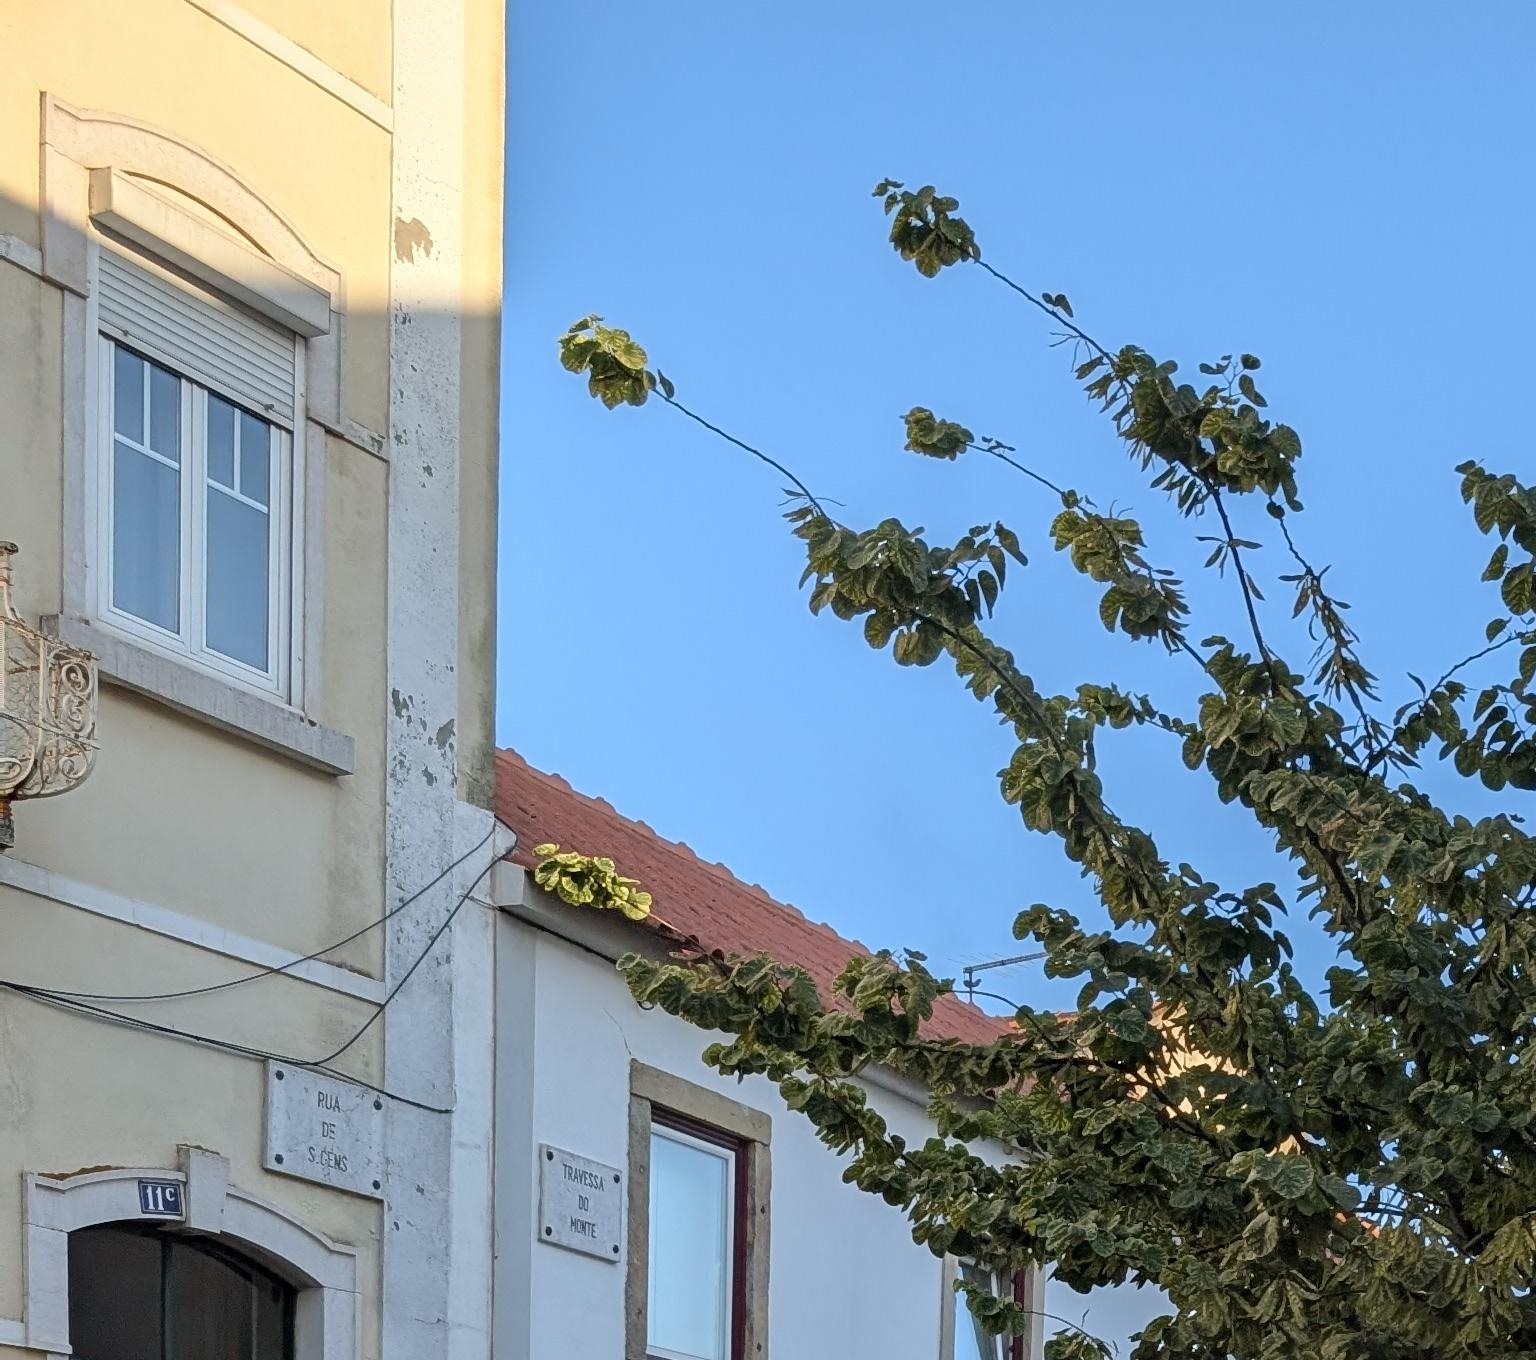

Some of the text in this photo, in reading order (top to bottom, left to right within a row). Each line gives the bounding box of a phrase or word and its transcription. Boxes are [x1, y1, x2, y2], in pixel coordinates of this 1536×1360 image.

[317, 1091, 341, 1113] RUA
[322, 1121, 337, 1140] DE
[562, 1163, 605, 1192] TRAVESSA
[578, 1194, 589, 1212] DO
[570, 1216, 597, 1239] MONTE
